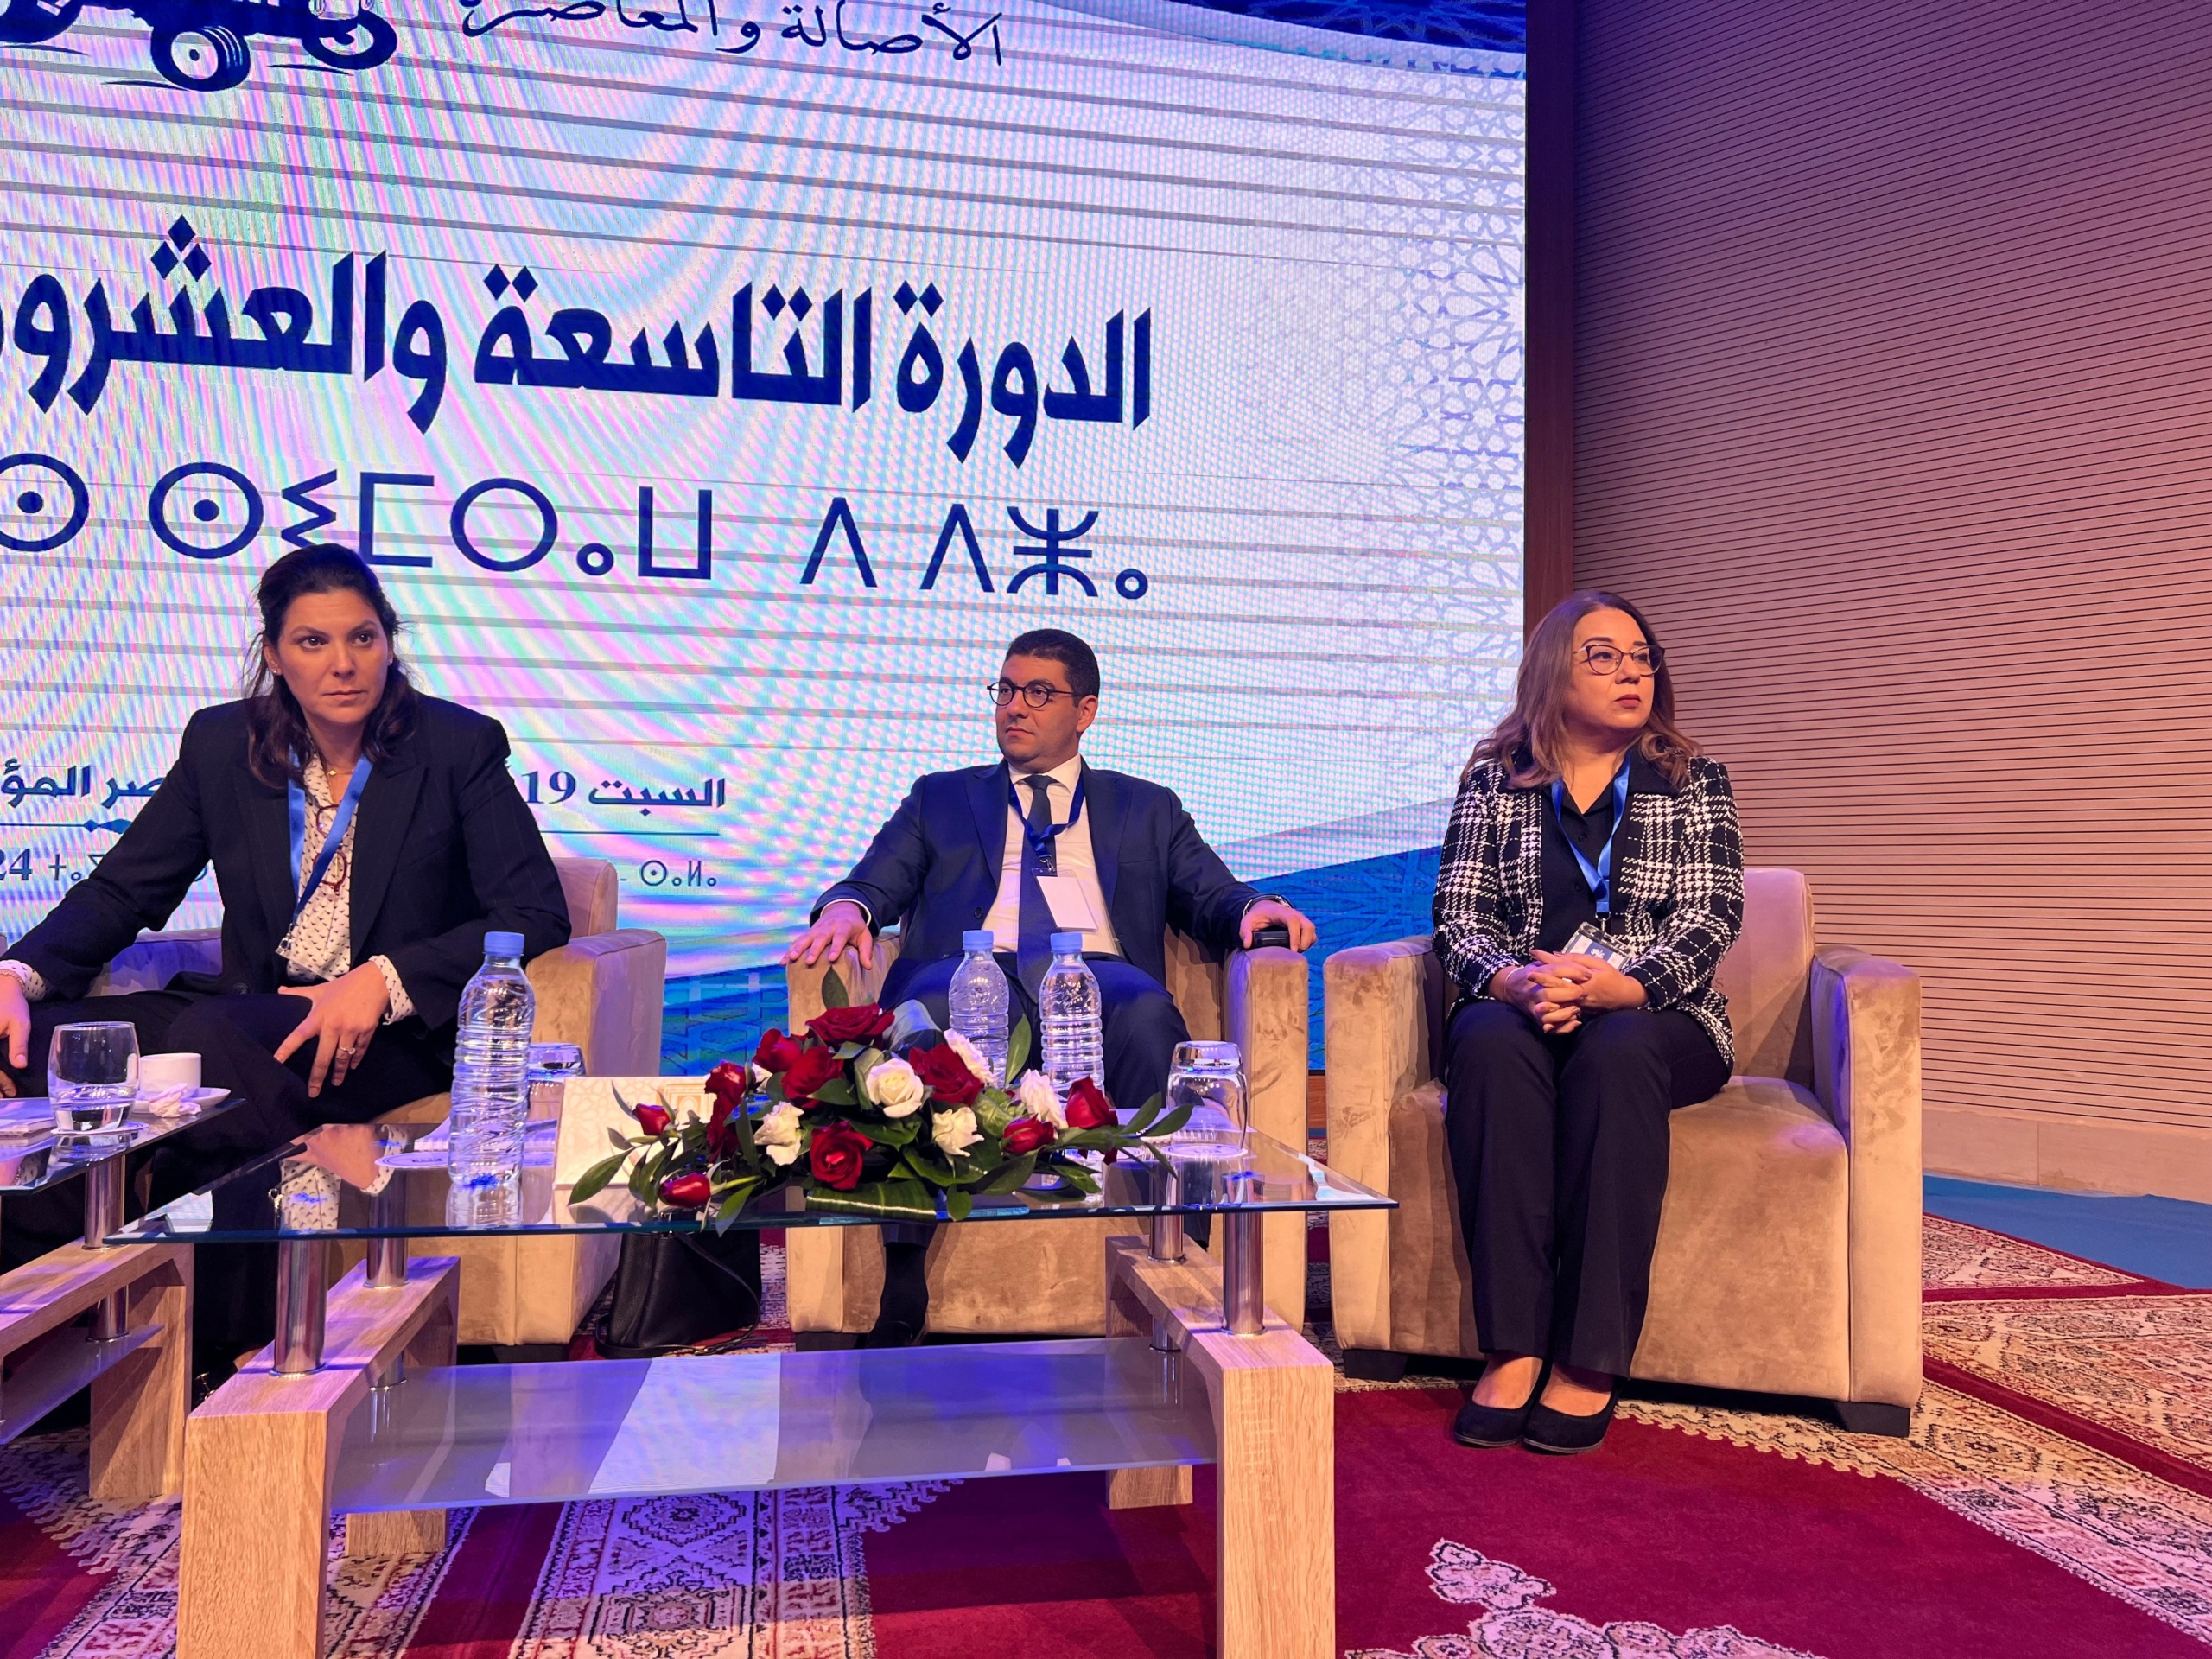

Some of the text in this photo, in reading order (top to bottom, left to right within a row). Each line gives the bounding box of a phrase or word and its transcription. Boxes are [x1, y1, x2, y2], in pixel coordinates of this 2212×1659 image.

[459, 0, 1002, 66] الأصالة والمعاصر
[0, 215, 1150, 469] الدورة التاسعة والعشرو
[100, 777, 167, 809] صر
[521, 771, 725, 816] السبت 19
